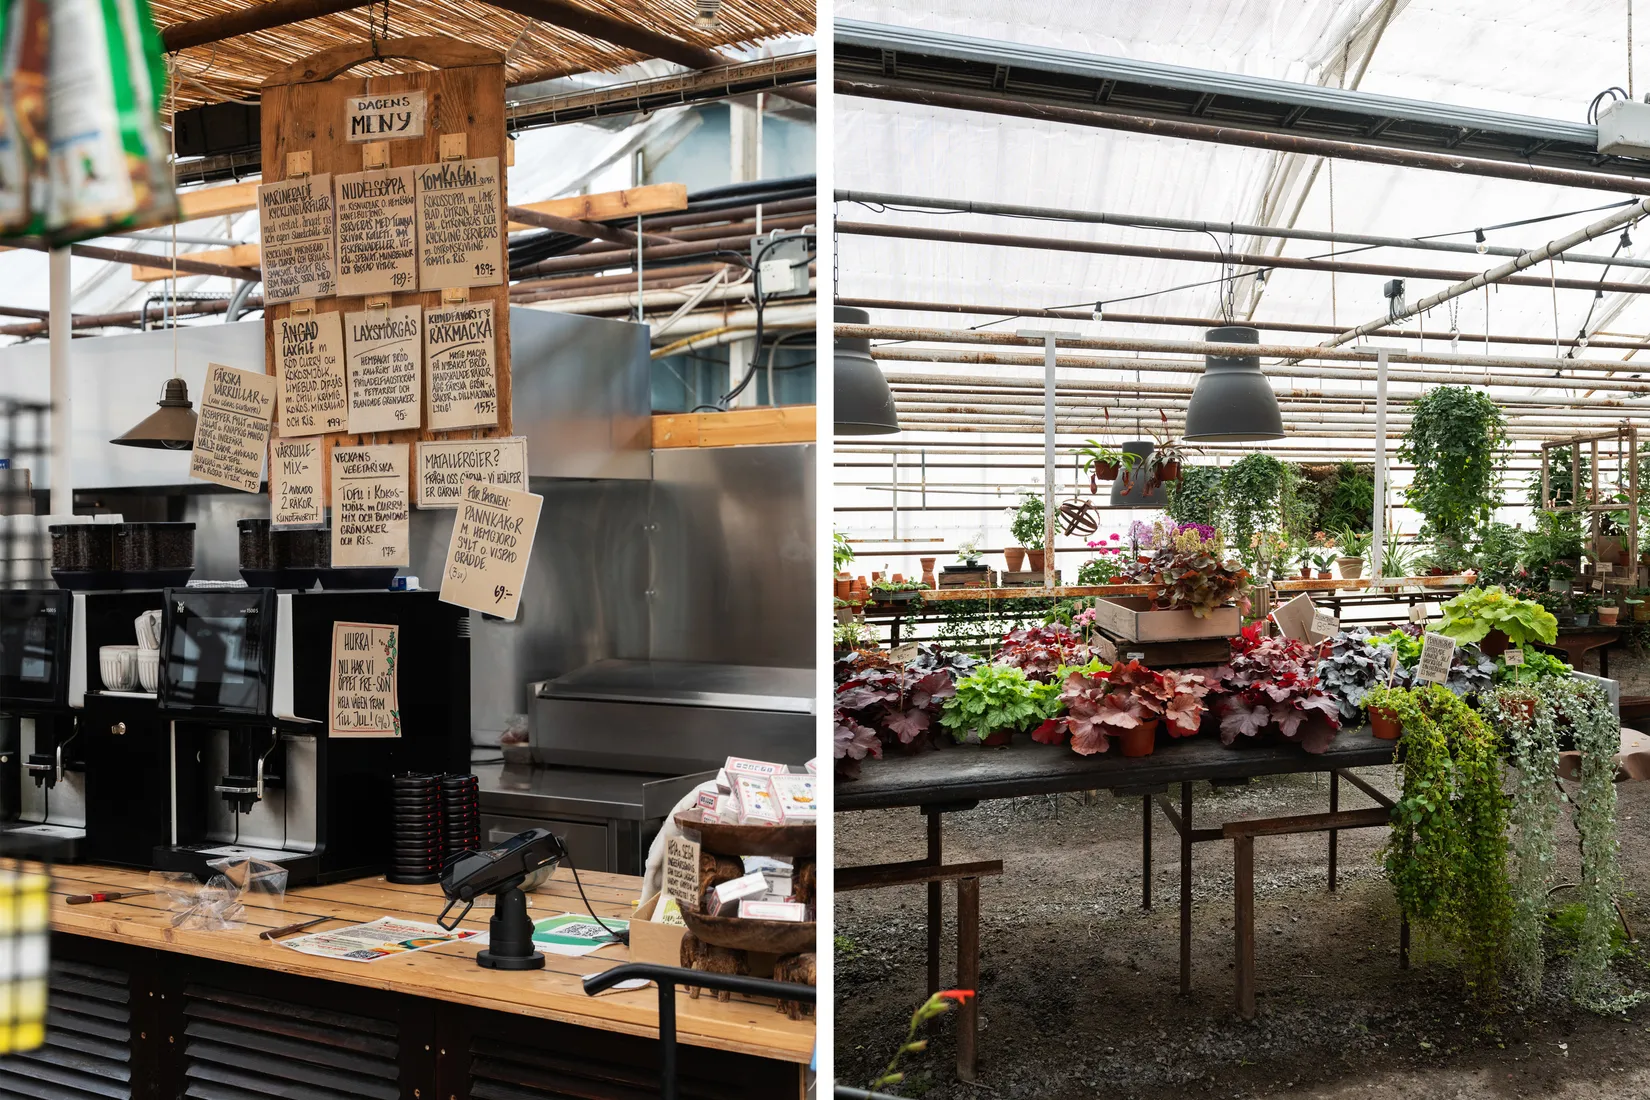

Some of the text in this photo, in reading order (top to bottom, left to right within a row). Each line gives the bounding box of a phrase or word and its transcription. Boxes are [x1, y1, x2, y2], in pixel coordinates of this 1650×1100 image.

[358, 97, 410, 110] DAGENS
[351, 112, 412, 135] MENY
[342, 176, 406, 200] NUDELSOPPA
[424, 192, 466, 208] KOKOSSOPPA
[375, 216, 390, 229] MED
[483, 215, 496, 225] OCH
[282, 321, 318, 344] ÅNGAD
[354, 315, 417, 342] LAXSMÖRGÅS
[430, 318, 492, 344] RÄKMACKA
[284, 355, 336, 369] RÖD CURRY OCH
[392, 364, 402, 373] LAX
[404, 362, 414, 371] OCH
[214, 368, 241, 386] FÄRSKA
[317, 388, 340, 403] KRÄMIG
[398, 385, 410, 394] OCH
[286, 416, 300, 427] OCH
[334, 452, 371, 463] VECKANS
[425, 449, 500, 469] MATALLERGIER?
[343, 460, 394, 474] VEGETARISKA
[424, 470, 445, 484] FRÅGA
[446, 474, 458, 484] OSS
[488, 471, 494, 483] VI
[497, 471, 522, 484] HJÄLPER
[282, 482, 288, 495] 2
[426, 486, 462, 498] ER GÄRNA!
[468, 484, 481, 501] FÖR
[281, 496, 314, 510] 2 RÄKOR
[342, 501, 366, 512] MJÖLK
[341, 510, 408, 522] MIX OCH BLANDADE
[464, 506, 524, 534] PANNKAKOR
[340, 537, 352, 546] OCH
[473, 526, 517, 548] HEMGJORD
[458, 536, 518, 564] SYLT VISPAD
[338, 657, 374, 675] NU HAR VI
[338, 674, 357, 691] ÖPPET
[338, 696, 350, 709] HELA
[370, 696, 384, 710] FRAM
